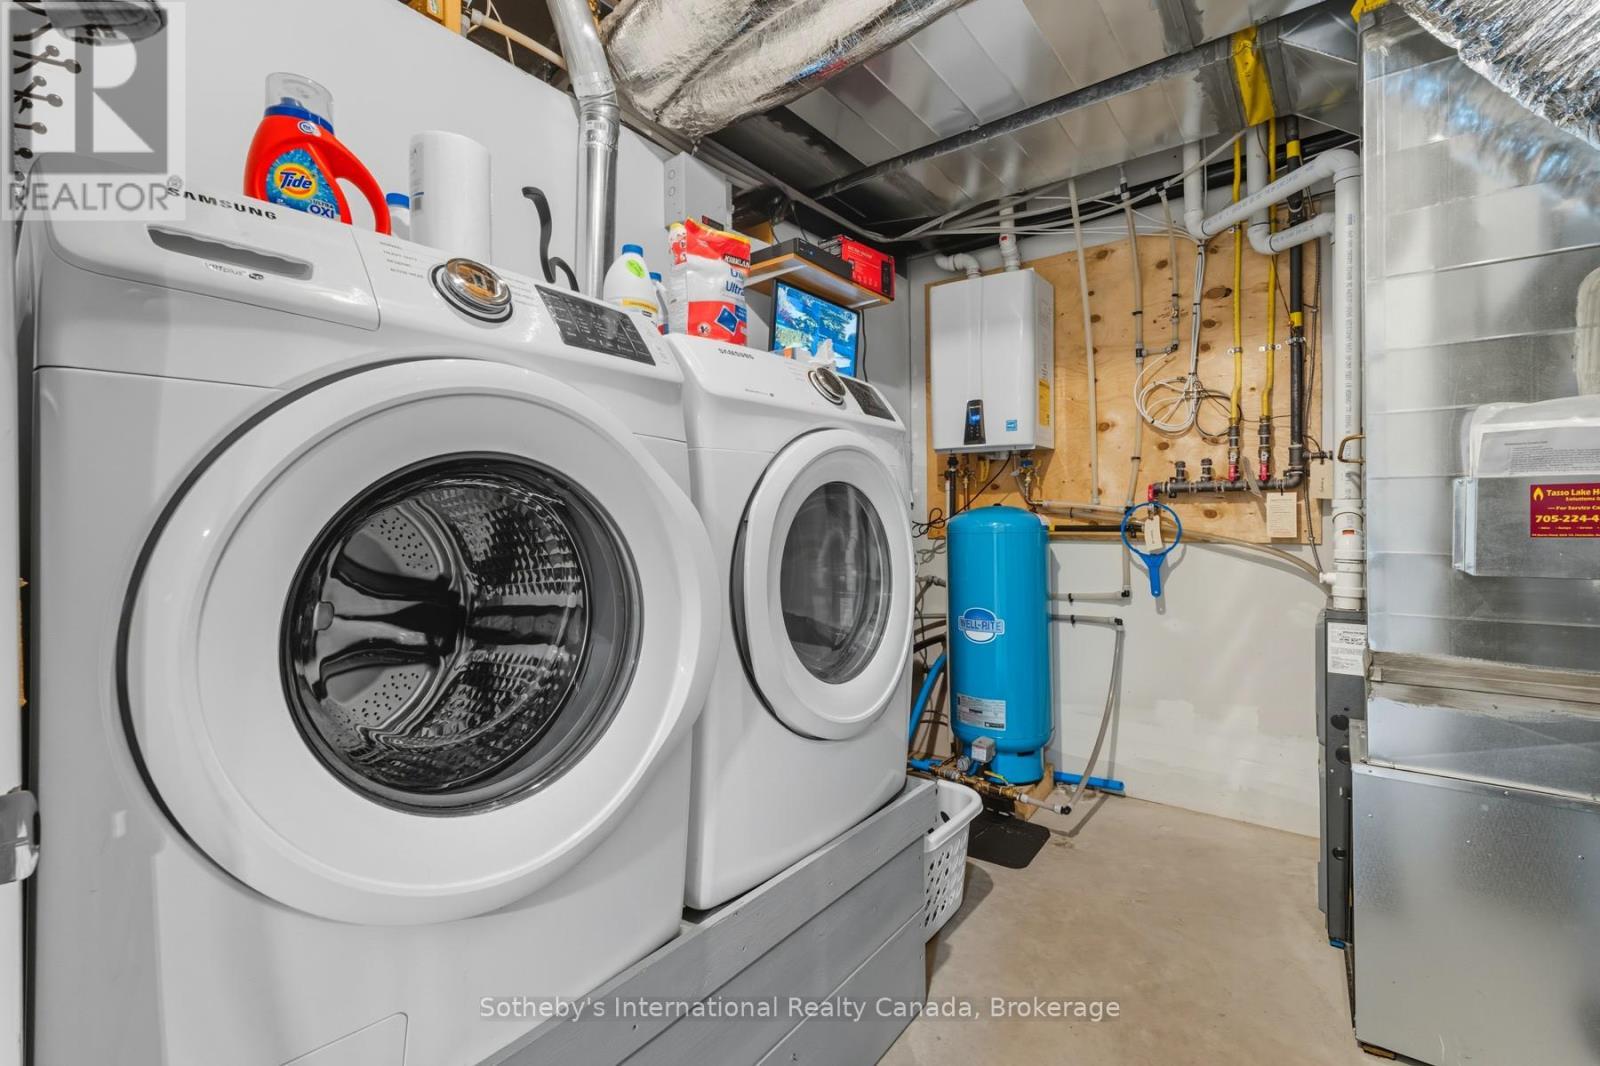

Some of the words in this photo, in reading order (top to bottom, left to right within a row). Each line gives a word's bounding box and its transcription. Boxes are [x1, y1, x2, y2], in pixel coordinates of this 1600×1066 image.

[280, 171, 312, 188] Tide
[167, 187, 277, 220] SAMSUNG
[309, 204, 334, 219] OXI
